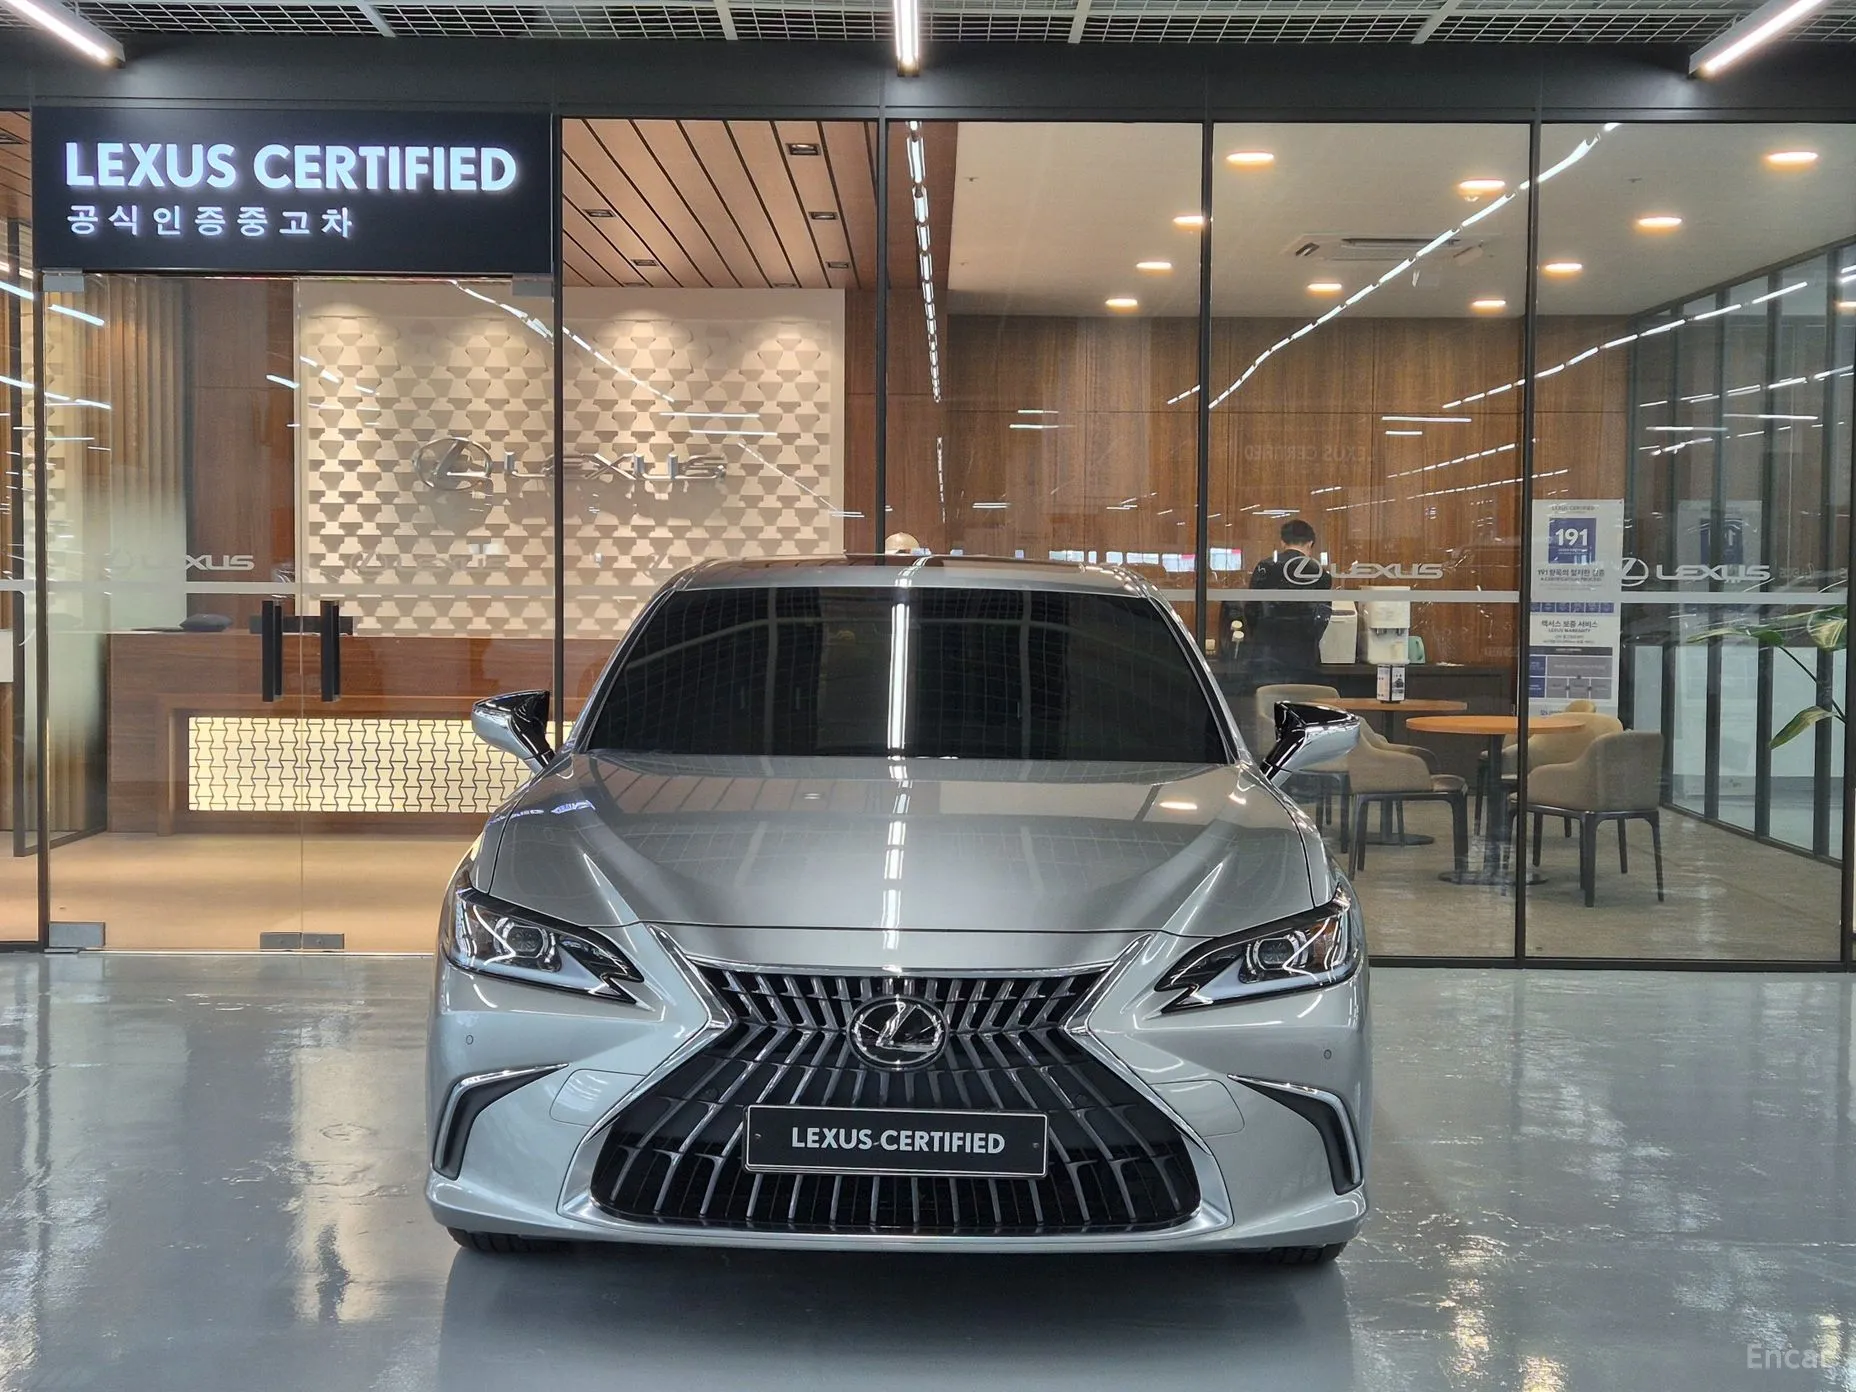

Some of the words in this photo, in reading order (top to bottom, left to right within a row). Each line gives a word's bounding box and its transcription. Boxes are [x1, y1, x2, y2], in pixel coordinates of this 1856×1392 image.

[65, 141, 236, 189] LEXUS
[253, 143, 518, 192] CERTIFIED
[503, 451, 727, 481] LEXUS
[1555, 528, 1589, 546] 191
[1331, 562, 1444, 580] LEXUS
[1656, 564, 1771, 582] LEXUS
[791, 1126, 873, 1150] LEXUS
[880, 1130, 1005, 1154] CERTIFIED
